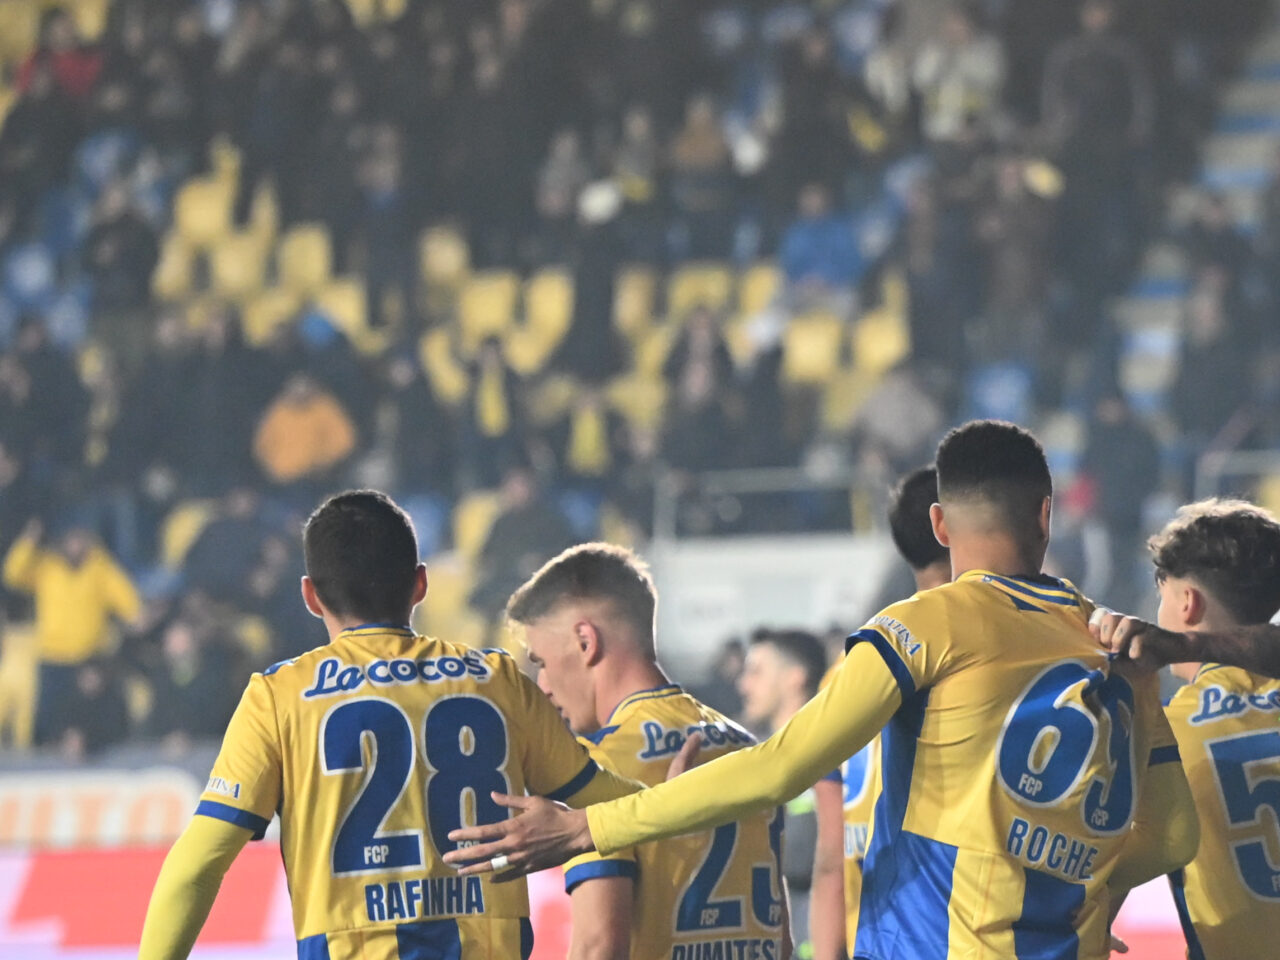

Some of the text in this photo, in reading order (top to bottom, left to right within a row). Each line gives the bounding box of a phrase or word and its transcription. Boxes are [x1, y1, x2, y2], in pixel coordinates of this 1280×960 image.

[318, 695, 511, 877] 28
[1018, 773, 1043, 797] FCP
[363, 844, 390, 865] FCP
[1006, 816, 1099, 883] ROCHE
[363, 876, 486, 923] RAFINHA
